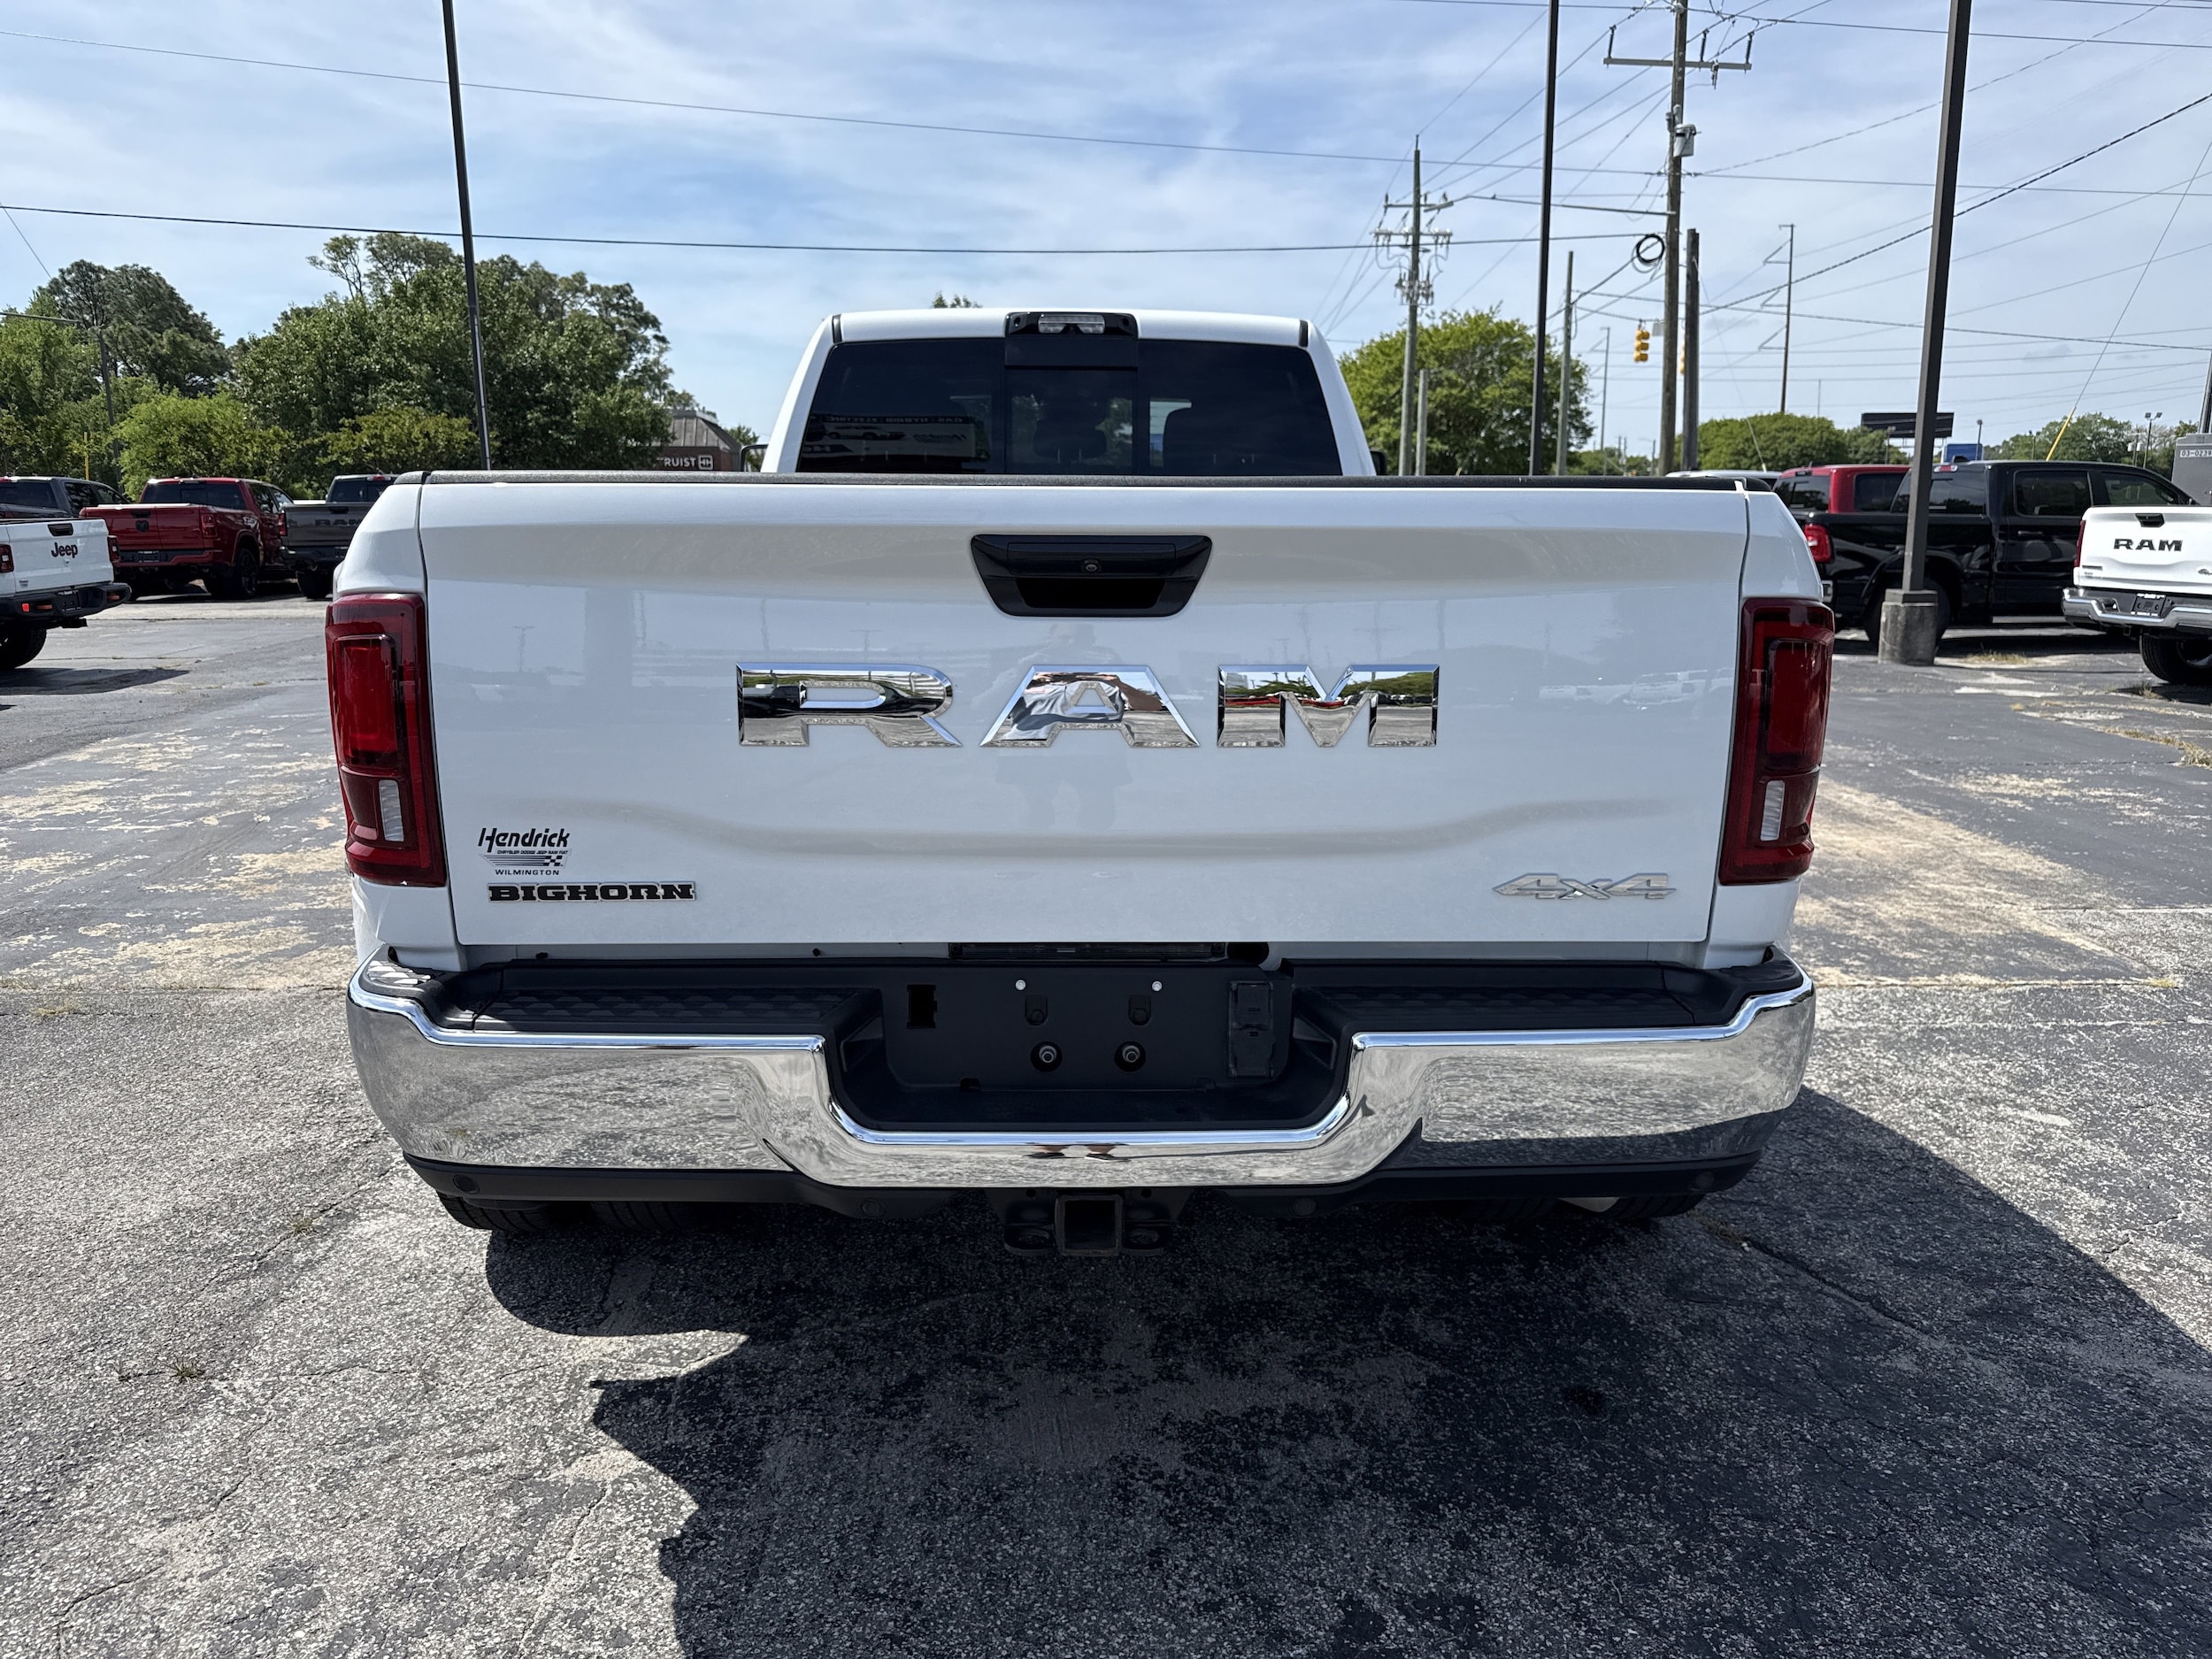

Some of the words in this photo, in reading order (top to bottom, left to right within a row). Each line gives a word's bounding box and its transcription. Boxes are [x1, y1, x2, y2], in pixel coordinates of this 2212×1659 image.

[50, 541, 78, 558] Jeep
[2113, 538, 2183, 551] RAM
[736, 663, 1440, 749] RAM
[478, 827, 571, 853] Hendrick
[488, 880, 696, 902] BIGHORN
